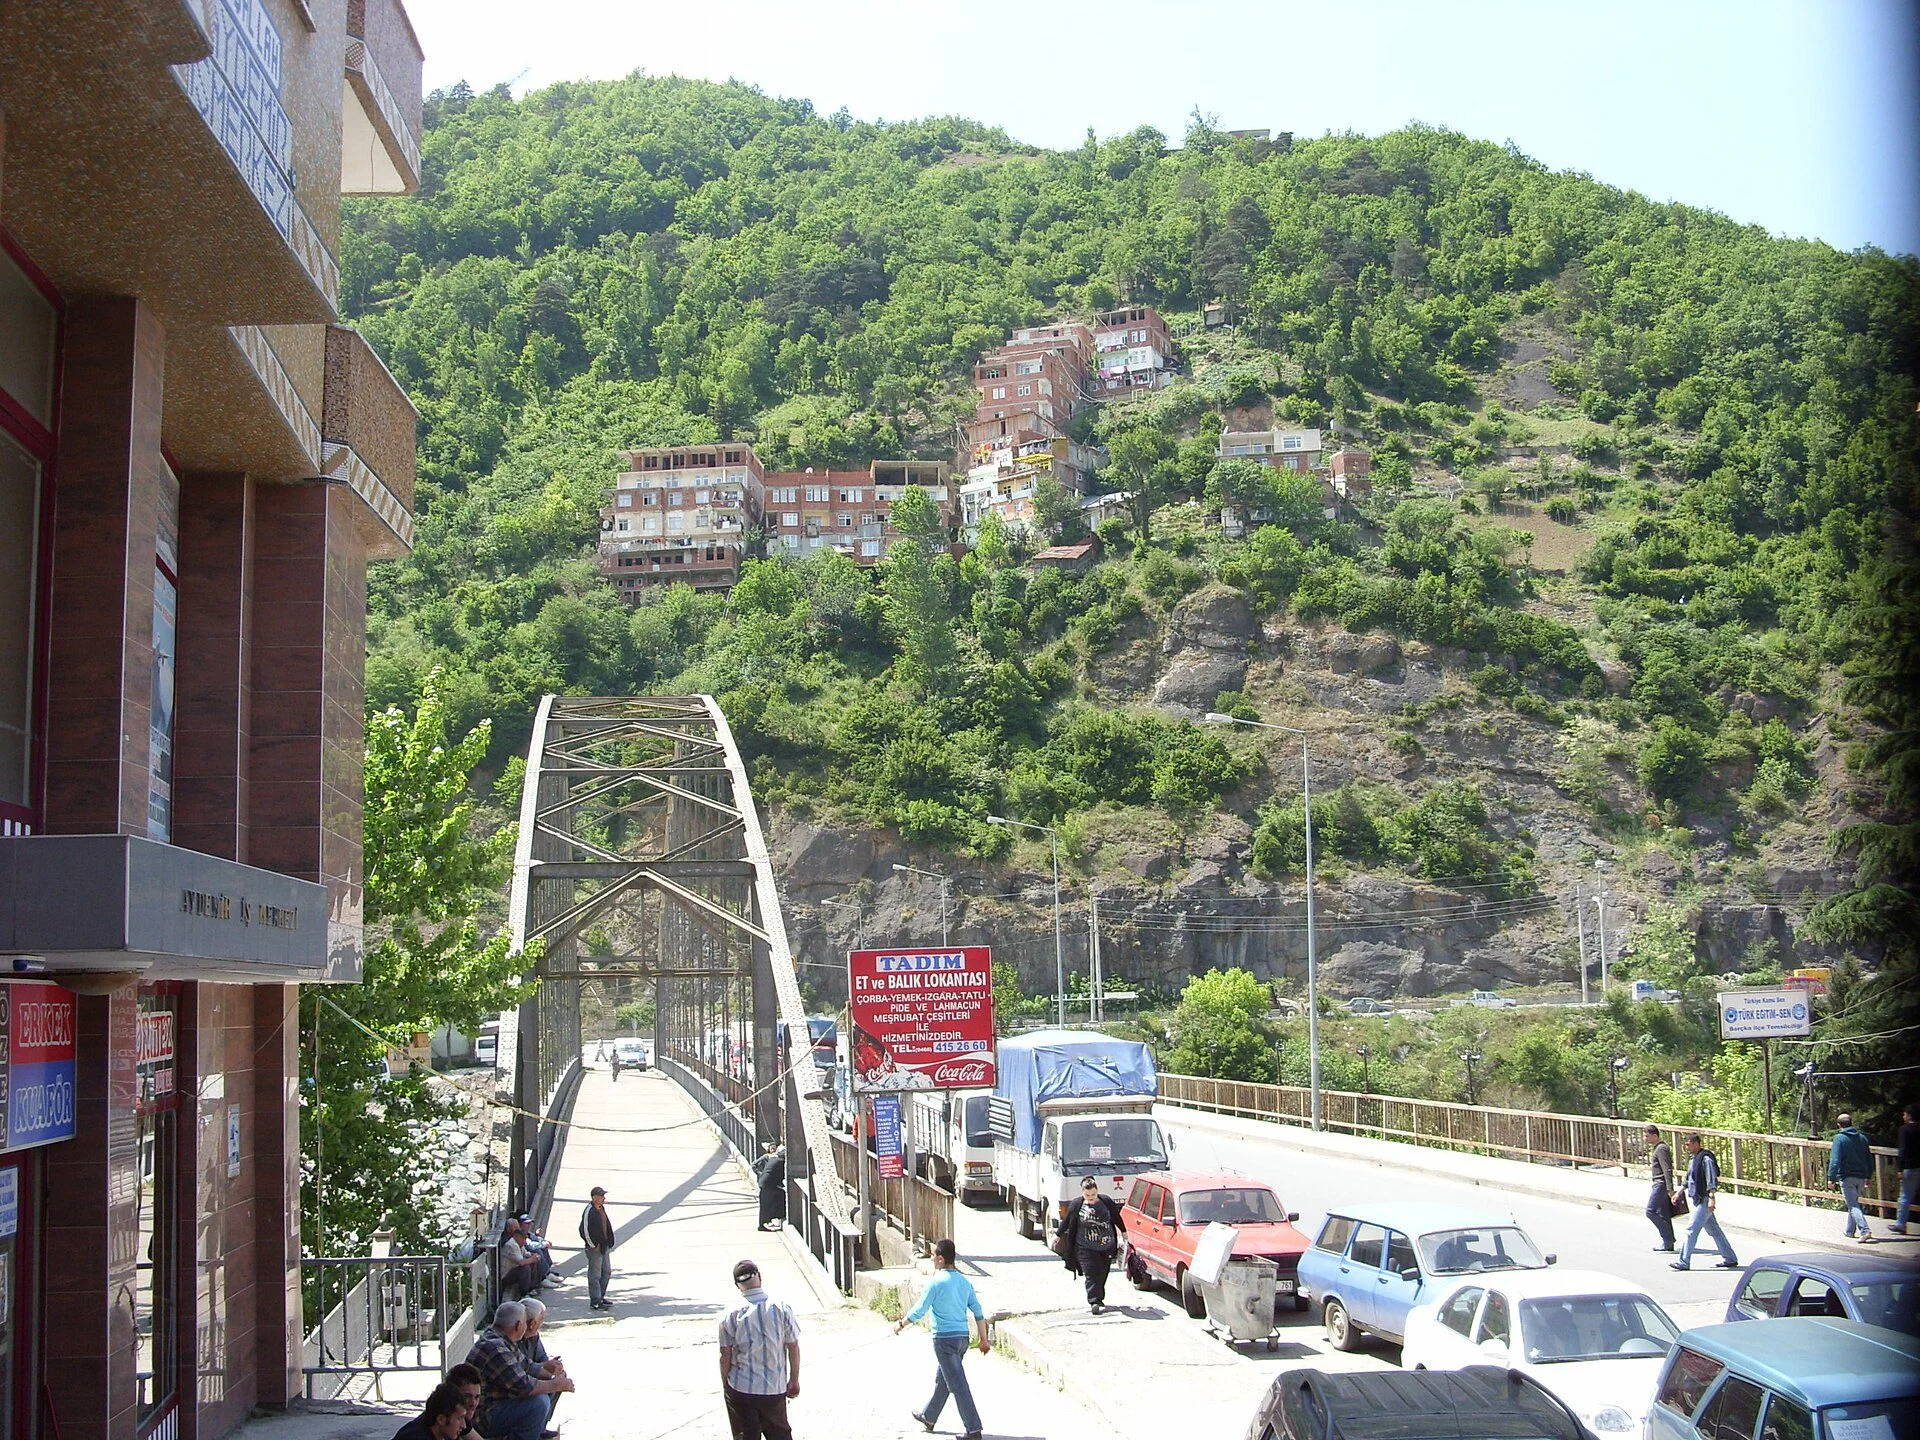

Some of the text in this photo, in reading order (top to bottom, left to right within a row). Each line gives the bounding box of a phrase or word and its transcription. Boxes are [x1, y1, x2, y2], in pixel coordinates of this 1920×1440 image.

[180, 887, 230, 920] AYDEMİR
[240, 897, 251, 927] İŞ
[881, 955, 962, 970] TADIM
[855, 972, 986, 990] ET ve BALIK LOKANTASI
[915, 1003, 928, 1011] VE
[933, 1001, 981, 1011] LAHMACUN
[873, 1011, 971, 1024] MEŞRUBAT ÇEŞİTLERİ
[1738, 1008, 1755, 1020] TÜRK
[19, 1002, 71, 1048] ERKEK
[915, 1021, 929, 1031] İLE
[935, 1043, 956, 1052] 415
[956, 1041, 970, 1051] 26
[972, 1041, 986, 1050] 60
[15, 1073, 73, 1133] KUAFÖR
[1281, 1281, 1292, 1290] 761
